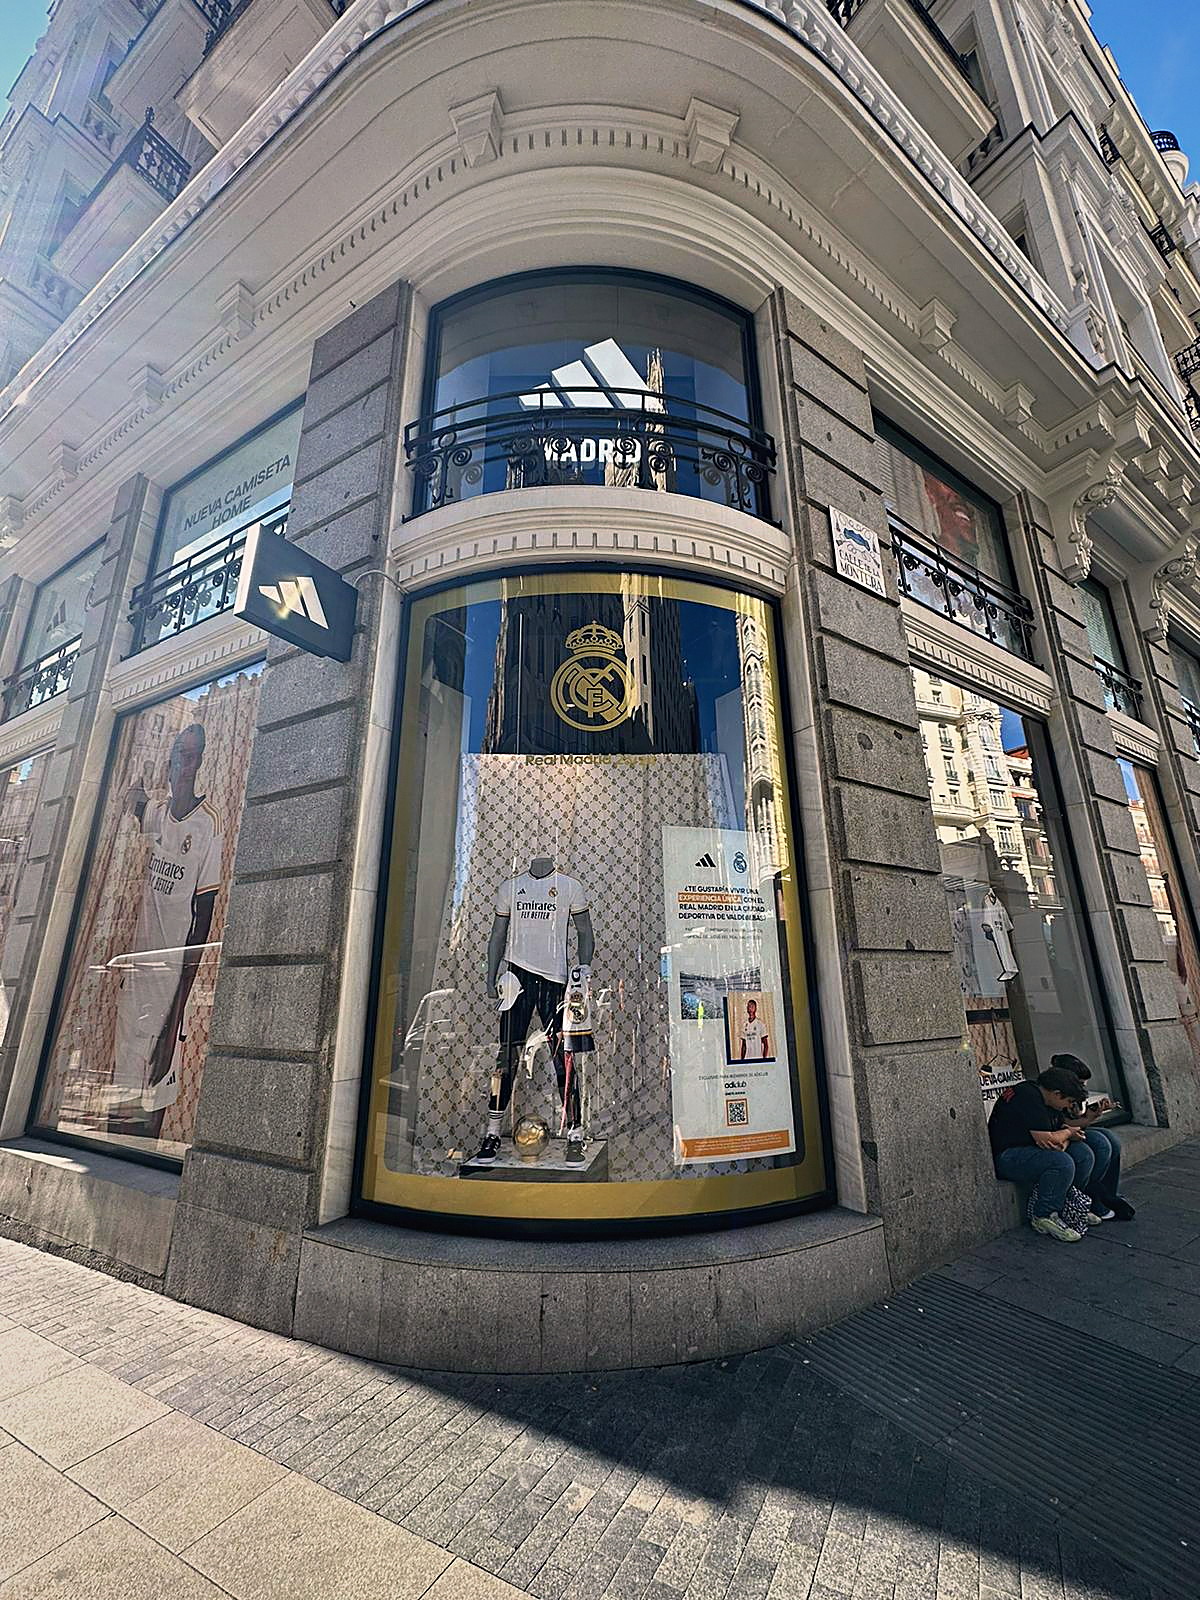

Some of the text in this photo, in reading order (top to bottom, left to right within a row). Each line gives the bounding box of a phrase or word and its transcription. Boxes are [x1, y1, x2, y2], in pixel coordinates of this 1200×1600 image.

[183, 454, 290, 531] NUEVA CAMISETA
[211, 495, 252, 530] HOME
[525, 753, 557, 766] Real
[559, 753, 612, 766] Madrid
[516, 901, 557, 912] Emirates
[697, 904, 724, 912] MADRID
[520, 911, 551, 920] FLY BETTER
